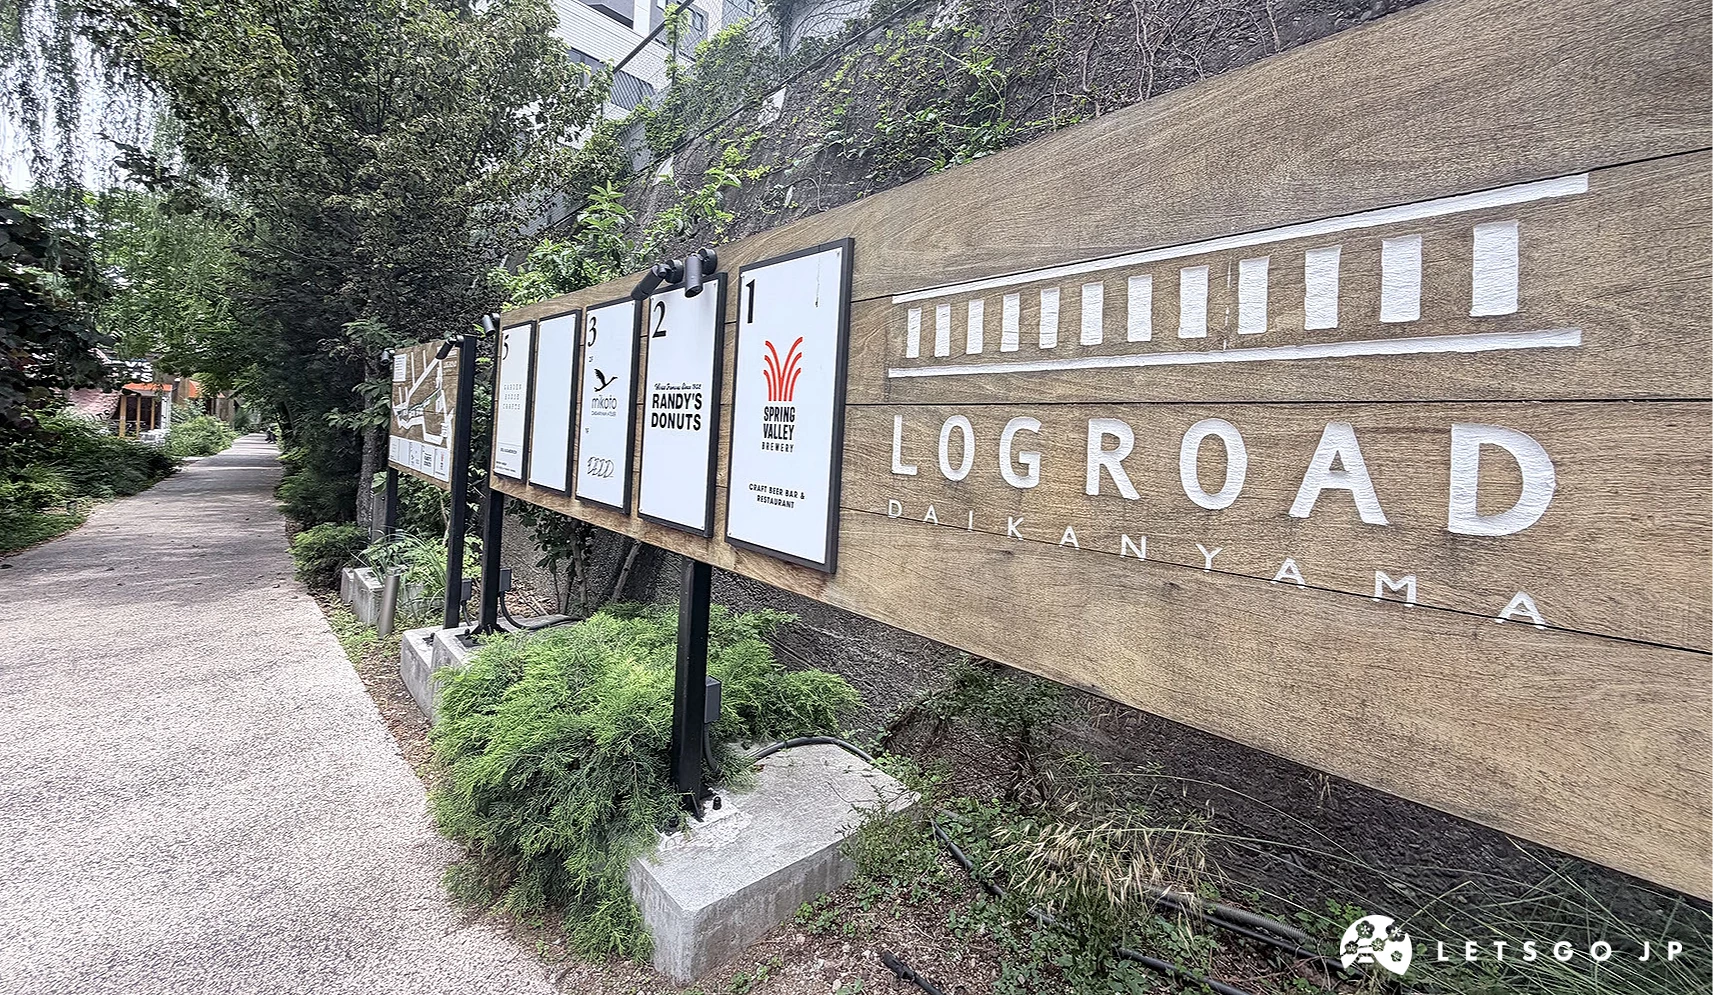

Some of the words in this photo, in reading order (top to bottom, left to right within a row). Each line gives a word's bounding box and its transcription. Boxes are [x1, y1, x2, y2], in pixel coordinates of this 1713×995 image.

[745, 278, 757, 324] 1
[652, 300, 667, 338] 2
[587, 316, 598, 348] 3
[652, 392, 703, 410] RANDY'S
[651, 412, 702, 431] DONUTS
[763, 406, 796, 422] SPRING
[763, 423, 795, 440] VALLEY
[761, 441, 794, 453] BREWERY
[890, 414, 1557, 537] LOGROAD
[748, 483, 768, 493] CRAFT
[768, 486, 783, 496] BEER
[785, 489, 798, 499] BAR
[800, 492, 805, 500] &
[756, 494, 795, 509] RESTAURANT
[887, 499, 1549, 630] DAIKANYAMA
